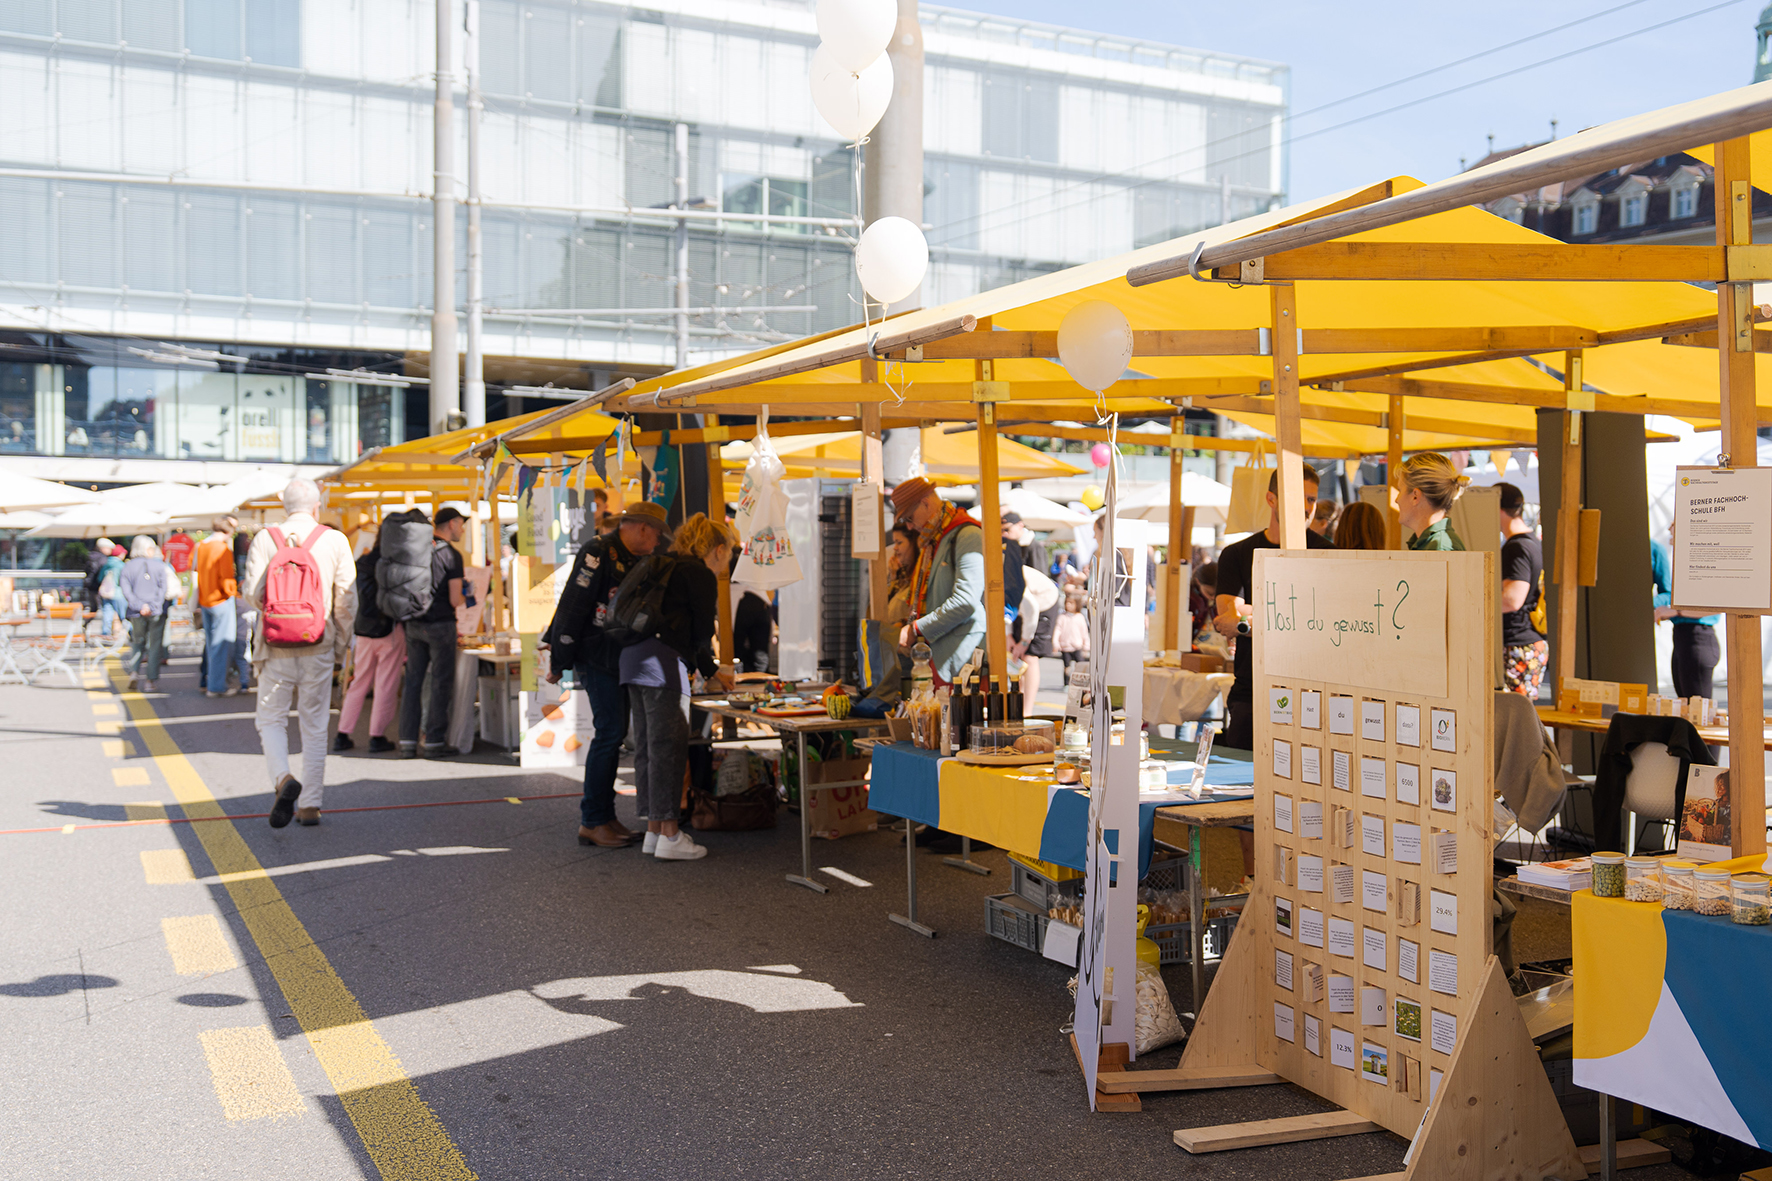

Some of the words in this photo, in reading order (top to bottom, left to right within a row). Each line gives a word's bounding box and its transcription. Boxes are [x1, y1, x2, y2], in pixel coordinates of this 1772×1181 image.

[242, 407, 276, 426] orell
[1690, 497, 1713, 506] BERNER
[1713, 495, 1749, 504] FACHHOCH-
[1690, 506, 1713, 515] SCHULE
[1266, 581, 1297, 631] Hast
[1307, 587, 1324, 632] du
[1337, 711, 1346, 719] du
[1401, 778, 1414, 787] 6500
[1435, 906, 1453, 917] 29.4%
[1336, 1043, 1352, 1053] 12.3%
